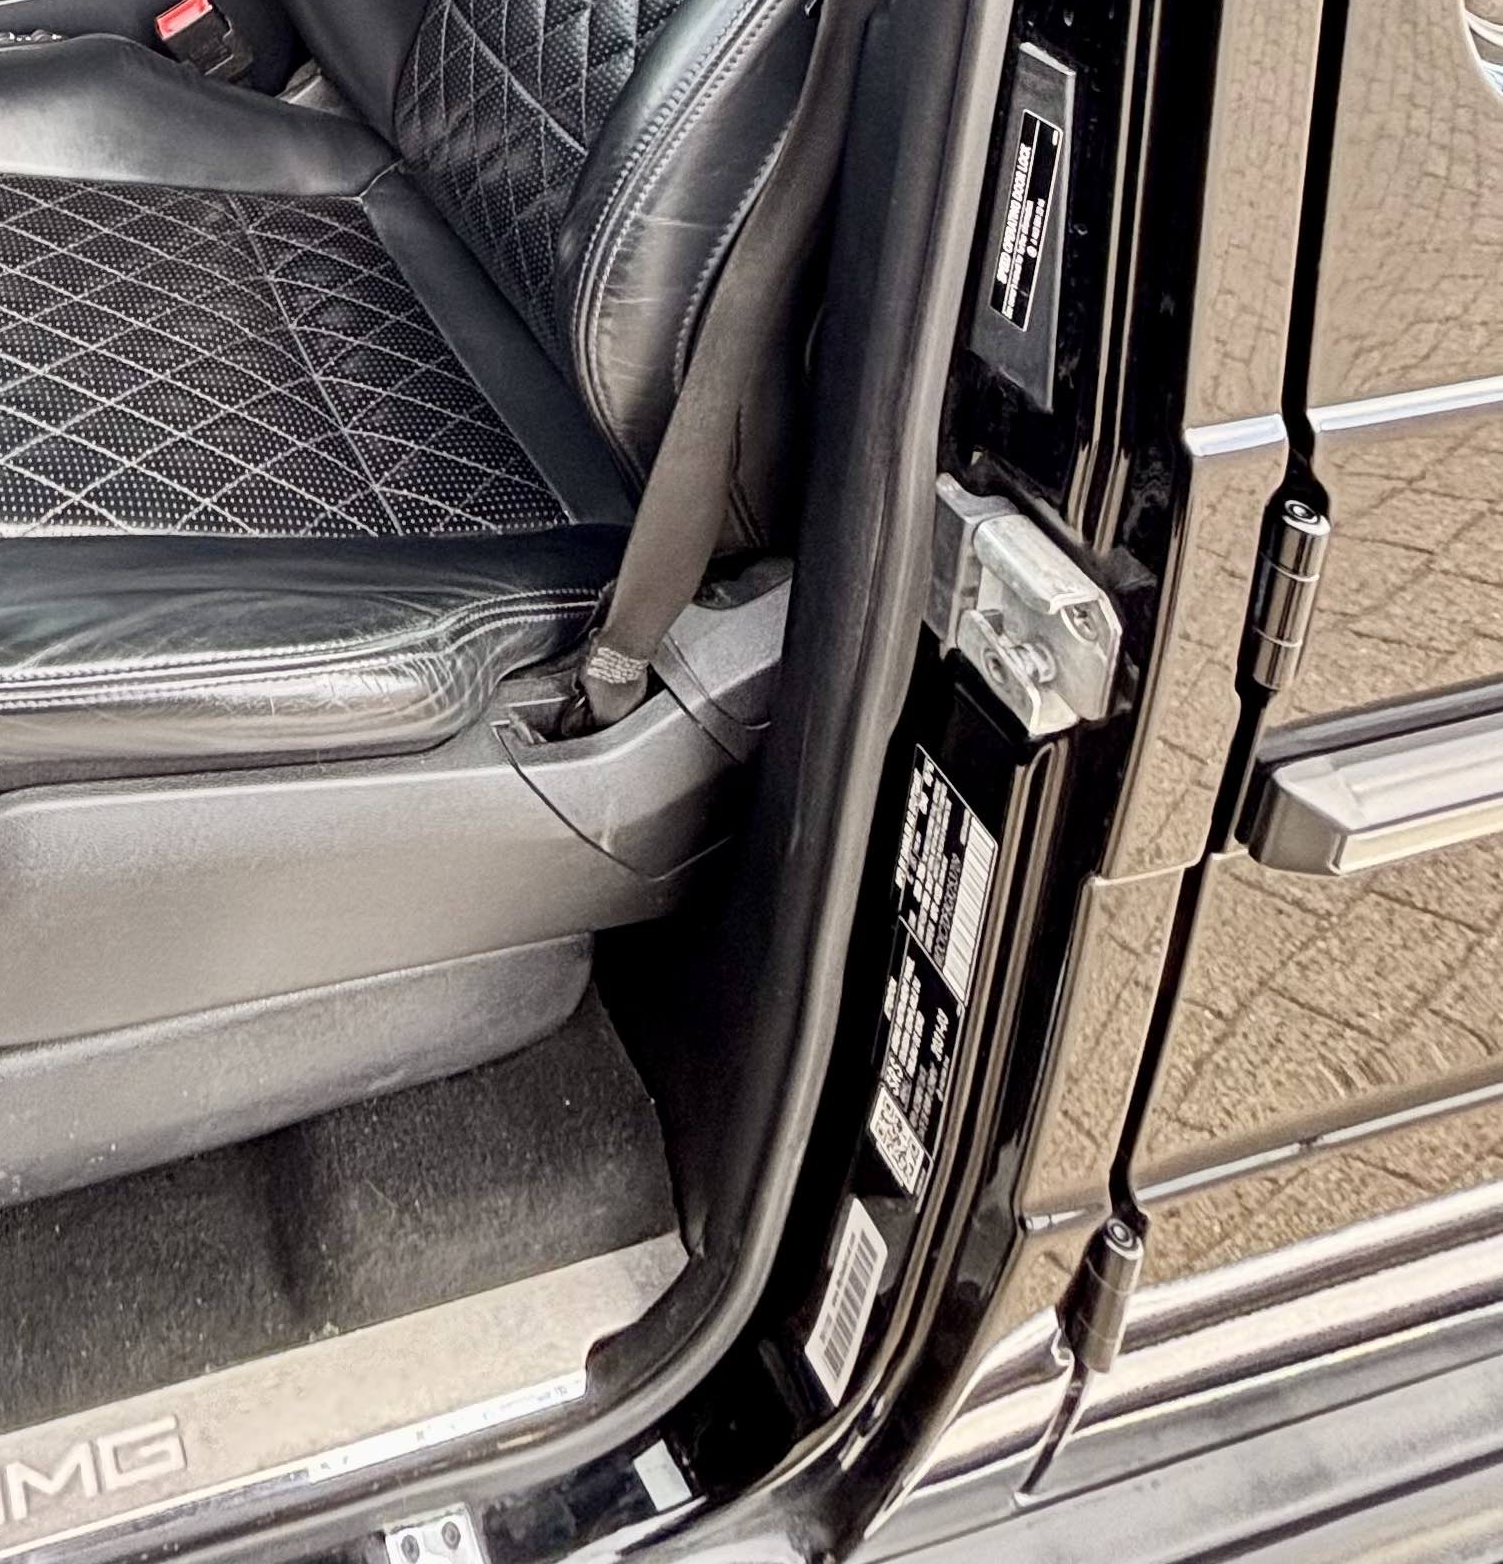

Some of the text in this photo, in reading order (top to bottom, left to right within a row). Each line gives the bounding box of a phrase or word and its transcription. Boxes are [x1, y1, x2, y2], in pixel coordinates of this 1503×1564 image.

[1016, 142, 1032, 172] LOCK
[1012, 170, 1027, 201] DOOR
[885, 1056, 904, 1096] SRS
